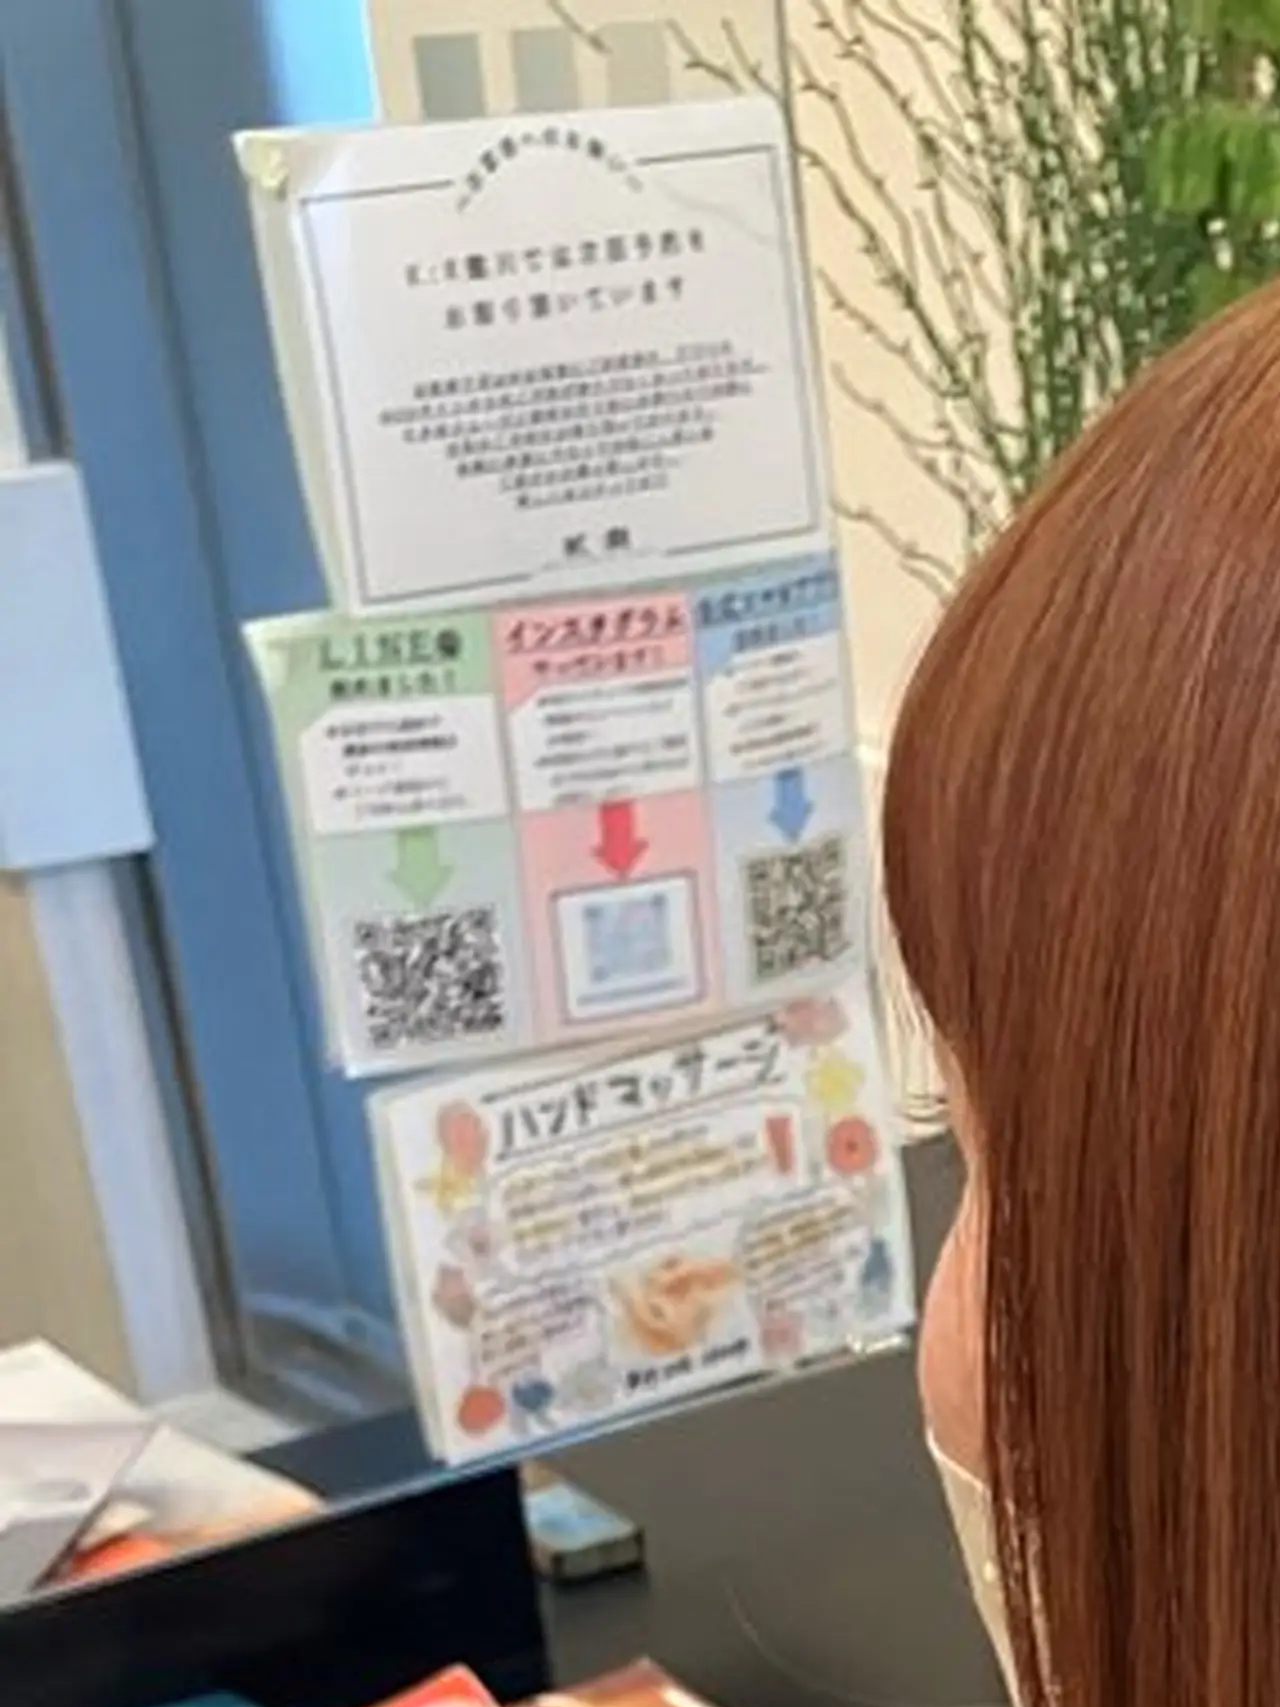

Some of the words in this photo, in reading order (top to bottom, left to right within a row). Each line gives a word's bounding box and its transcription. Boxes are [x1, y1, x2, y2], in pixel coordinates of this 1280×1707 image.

[505, 606, 682, 654] インスタグラム
[500, 1030, 788, 1147] ハンドマッサージ
